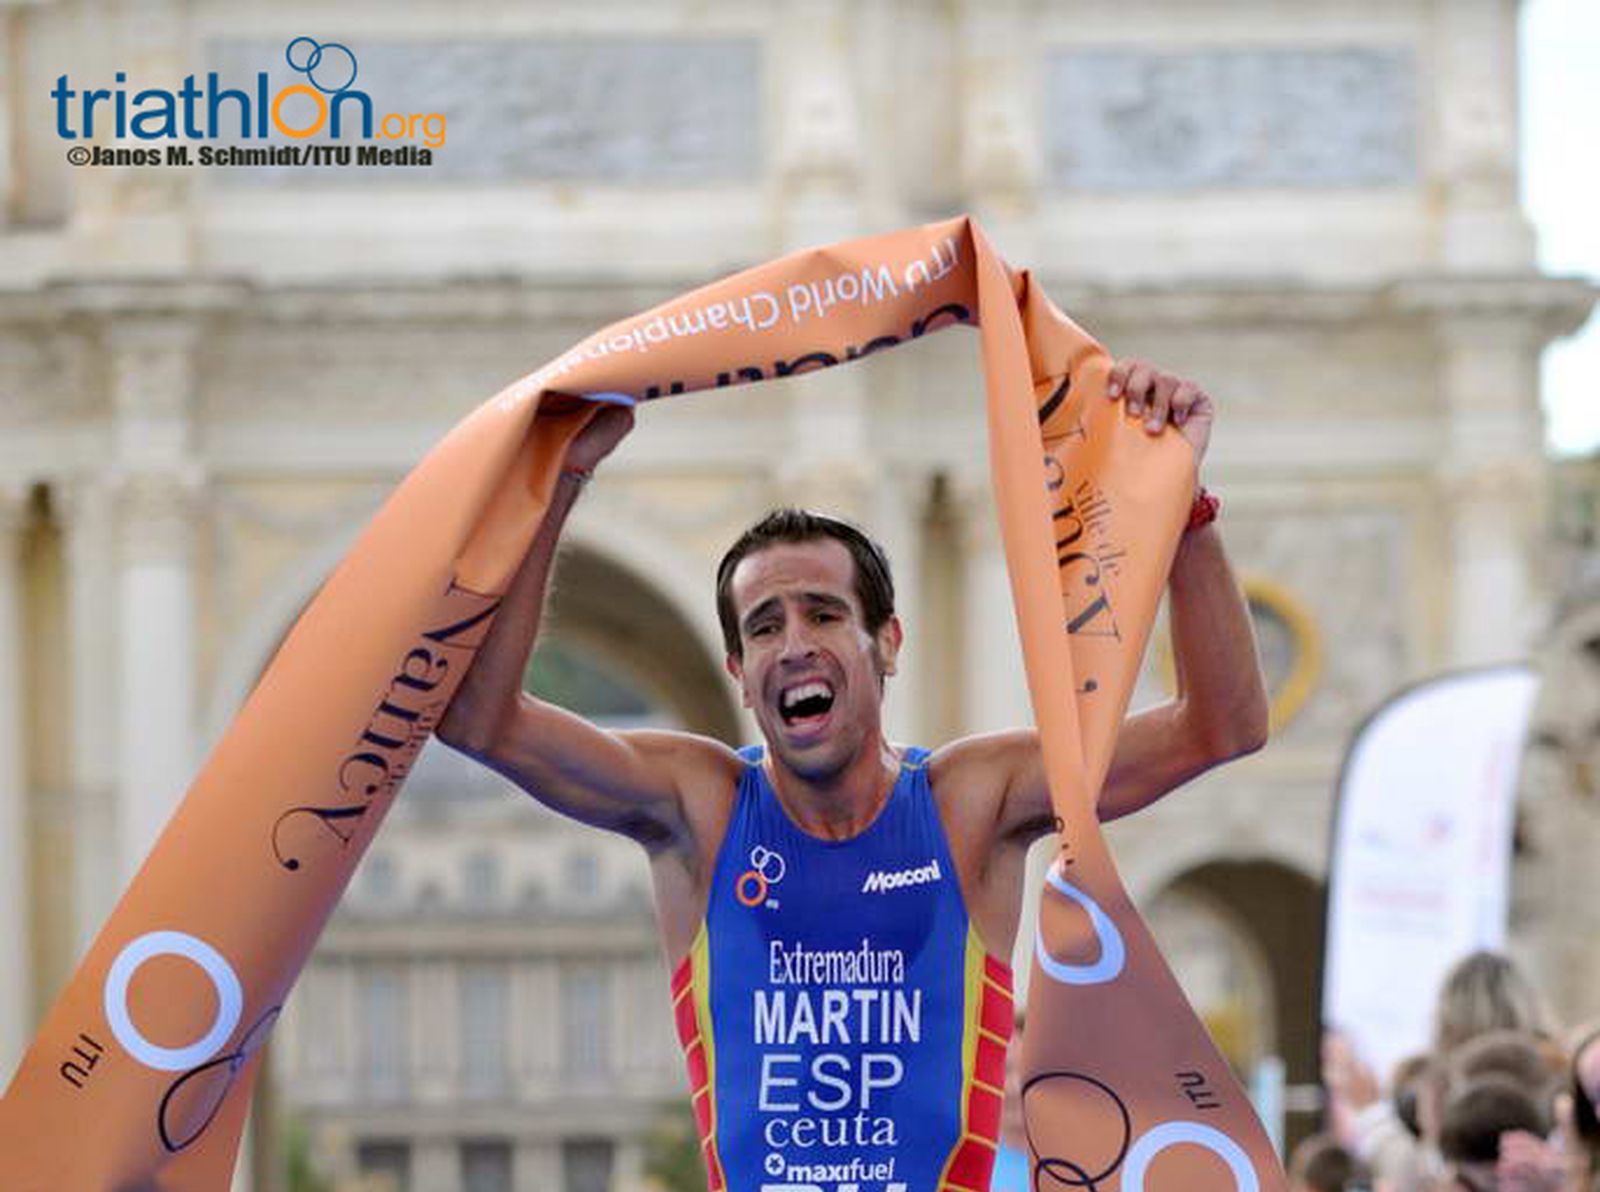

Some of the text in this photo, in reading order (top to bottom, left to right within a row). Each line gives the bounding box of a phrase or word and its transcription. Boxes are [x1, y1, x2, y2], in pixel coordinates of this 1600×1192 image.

[788, 264, 897, 324] World
[272, 577, 504, 871] Nancy
[769, 938, 904, 984] Extremadura
[754, 988, 921, 1045] MARTIN
[60, 1033, 104, 1089] ITU
[758, 1053, 904, 1112] ESP
[1175, 1070, 1221, 1110] ITU
[764, 1110, 898, 1148] ceuta
[786, 1157, 895, 1182] maxifuel
